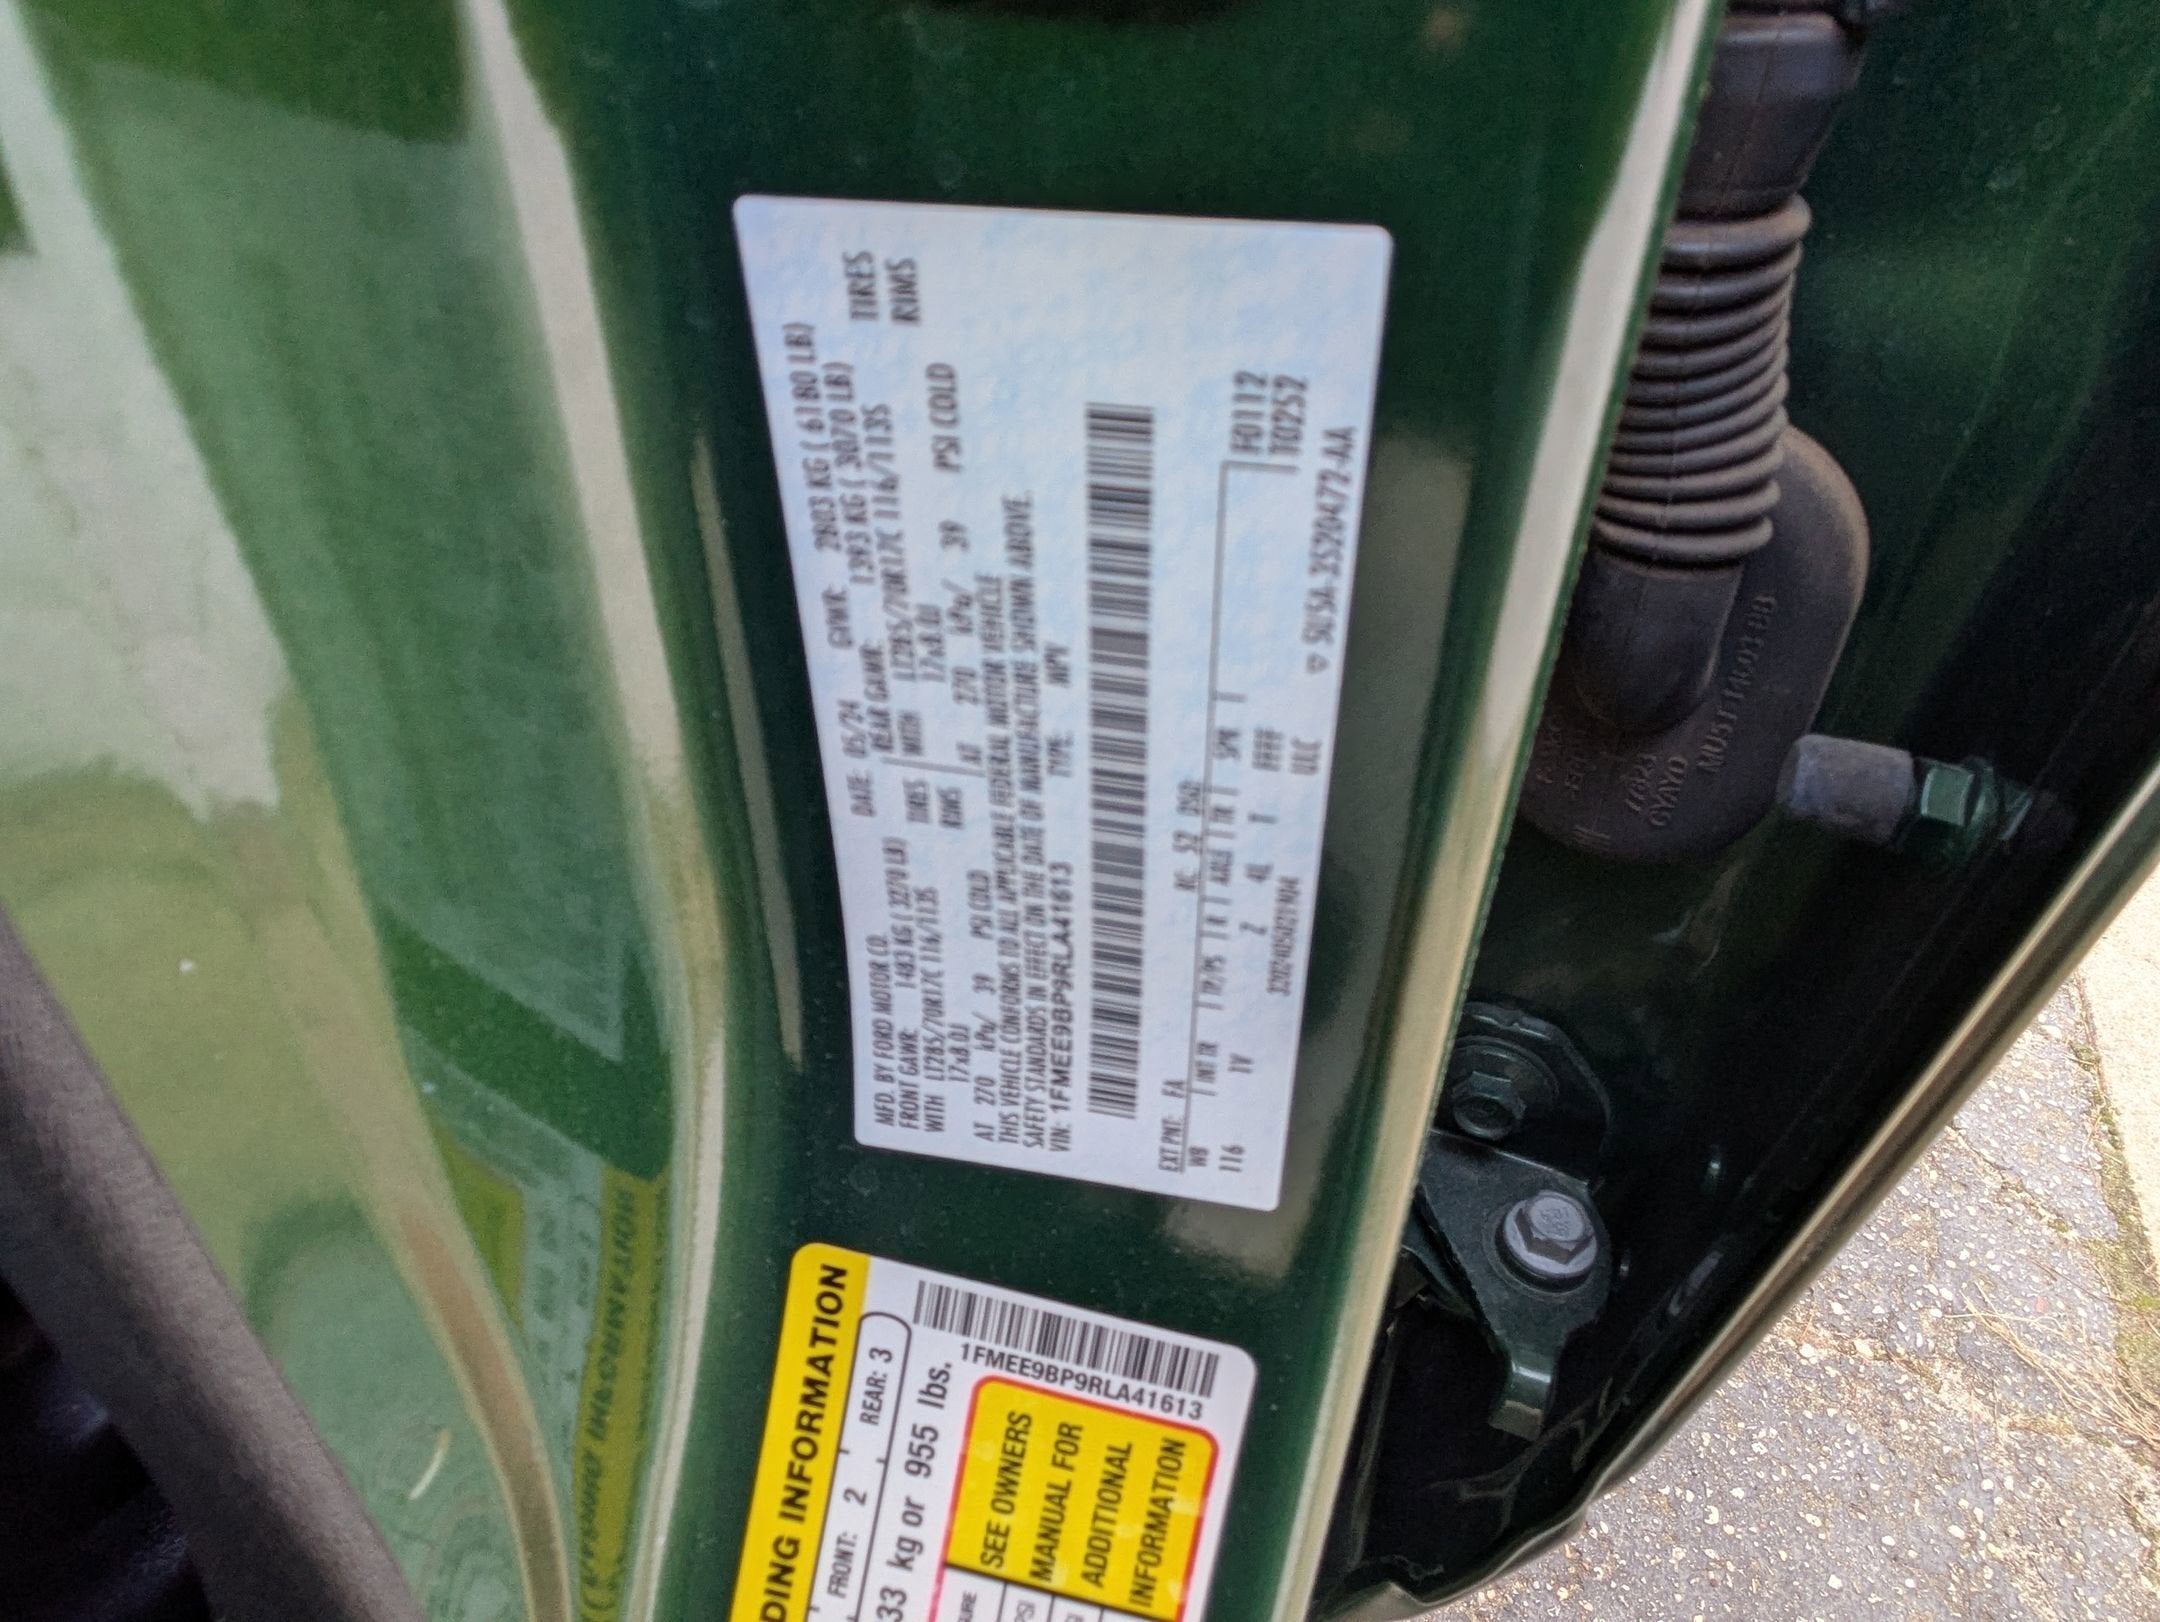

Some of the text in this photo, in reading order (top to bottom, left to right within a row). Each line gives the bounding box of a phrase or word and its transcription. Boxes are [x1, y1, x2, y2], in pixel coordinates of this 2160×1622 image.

[842, 251, 878, 321] TIRES
[884, 258, 921, 324] RIMS
[782, 323, 816, 364] LB)
[789, 371, 826, 433] 6180
[822, 362, 854, 402] LB)
[925, 363, 959, 429] COLD
[1229, 370, 1267, 455] F0112
[829, 409, 862, 471] 3070
[931, 435, 962, 471] PSI
[802, 459, 832, 490] KG
[808, 496, 841, 551] 2803
[839, 493, 867, 525] KG
[844, 531, 874, 585] 1393
[938, 520, 969, 553] 39
[1009, 577, 1036, 652] SHOWN
[951, 666, 979, 705] 270
[838, 700, 867, 758] 05/24
[866, 706, 894, 753] REAR
[898, 711, 923, 756] WITH
[1011, 660, 1042, 794] MANUFACTURE
[1017, 799, 1044, 821] OF
[973, 573, 1022, 1144] THIS VEHICLE CONFORMS TO ALL APPLICABLE FEDERAL MOTOR VEHICLE
[1018, 826, 1044, 866] DATE
[886, 870, 911, 910] 3270
[966, 870, 991, 912] COLD
[1020, 871, 1044, 899] THE
[891, 925, 914, 945] KG
[969, 916, 993, 940] PSI
[1022, 905, 1045, 926] ON
[893, 947, 917, 989] 1483
[1022, 930, 1047, 980] EFFECT
[972, 974, 996, 995] 39
[1023, 985, 1046, 1001] IN
[1049, 861, 1074, 1112] 1FMEE9BP9RLA41613
[866, 935, 896, 1126] MFD. BY FORD MOTOR CO.
[898, 1030, 920, 1076] GAWR:
[1023, 1006, 1047, 1093] STANDARDS
[1196, 1041, 1218, 1057] TR
[974, 1076, 996, 1106] 270
[1161, 1079, 1185, 1099] FA
[1194, 1061, 1216, 1083] INT
[898, 1081, 920, 1130] FRONT
[924, 1095, 945, 1132] WITH
[1023, 1098, 1045, 1148] SAFETY
[974, 1122, 994, 1142] AT
[1158, 1147, 1180, 1173] EXT
[1187, 1146, 1208, 1168] WB
[1218, 1144, 1245, 1173] 116
[916, 1361, 952, 1409] lbs.
[959, 1342, 1203, 1421] 1FMEE9BP9RLA41613
[760, 1262, 848, 1622] DING INFORMATION
[904, 1424, 940, 1479] 955
[827, 1346, 893, 1599] FRONT: 2 REAR: 3
[979, 1409, 1032, 1569] SEE OWNERS
[901, 1496, 925, 1528] or
[1029, 1421, 1082, 1582] MANUAL FOR
[1081, 1441, 1132, 1588] ADDITIONAL
[1129, 1435, 1187, 1608] INFORMATION
[885, 1535, 924, 1572] kg
